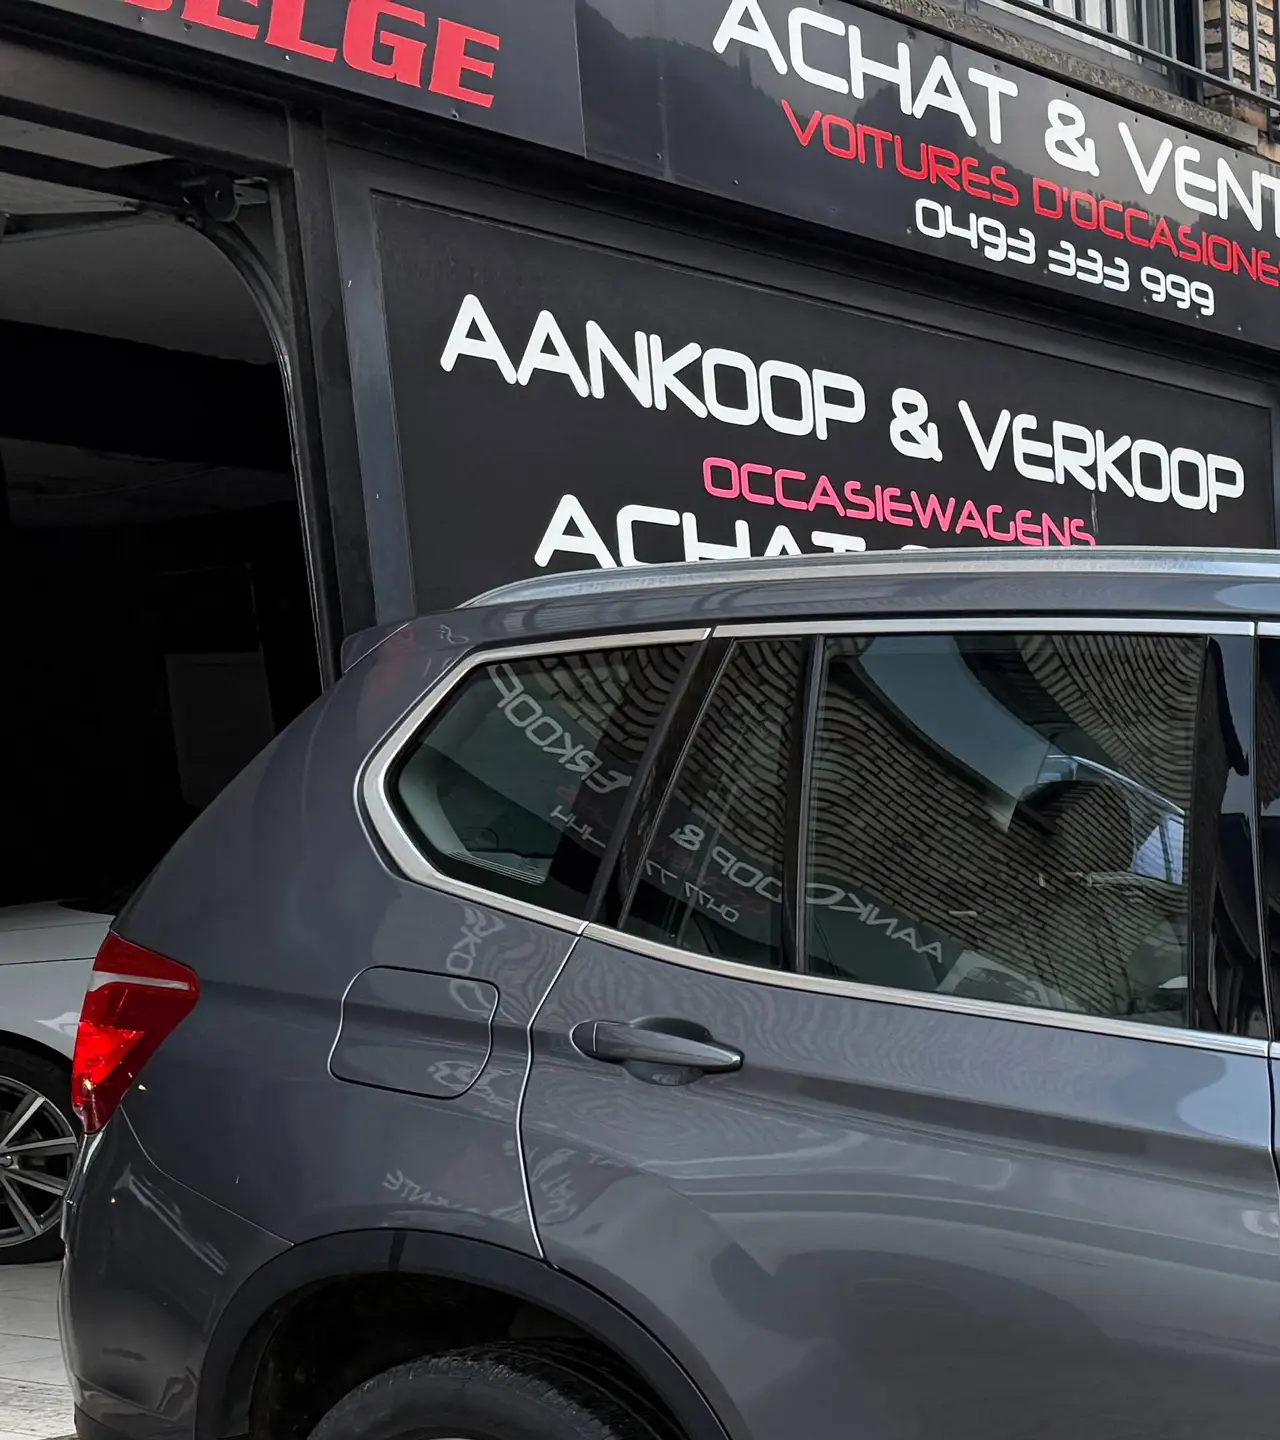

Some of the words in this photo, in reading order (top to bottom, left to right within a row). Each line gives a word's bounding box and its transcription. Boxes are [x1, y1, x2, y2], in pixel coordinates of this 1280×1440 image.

[122, 0, 500, 108] ELGE
[712, 0, 1018, 144] ACHAT
[1045, 99, 1099, 176] &
[781, 99, 1019, 207] VOITURES
[915, 198, 1036, 265] 0493
[1047, 240, 1130, 292] 333
[1140, 266, 1215, 316] 999
[440, 294, 866, 441] AANKOOP
[890, 387, 943, 463] &
[958, 400, 1244, 513] VERKOOP
[702, 457, 1097, 547] OCCASIEWAGENS
